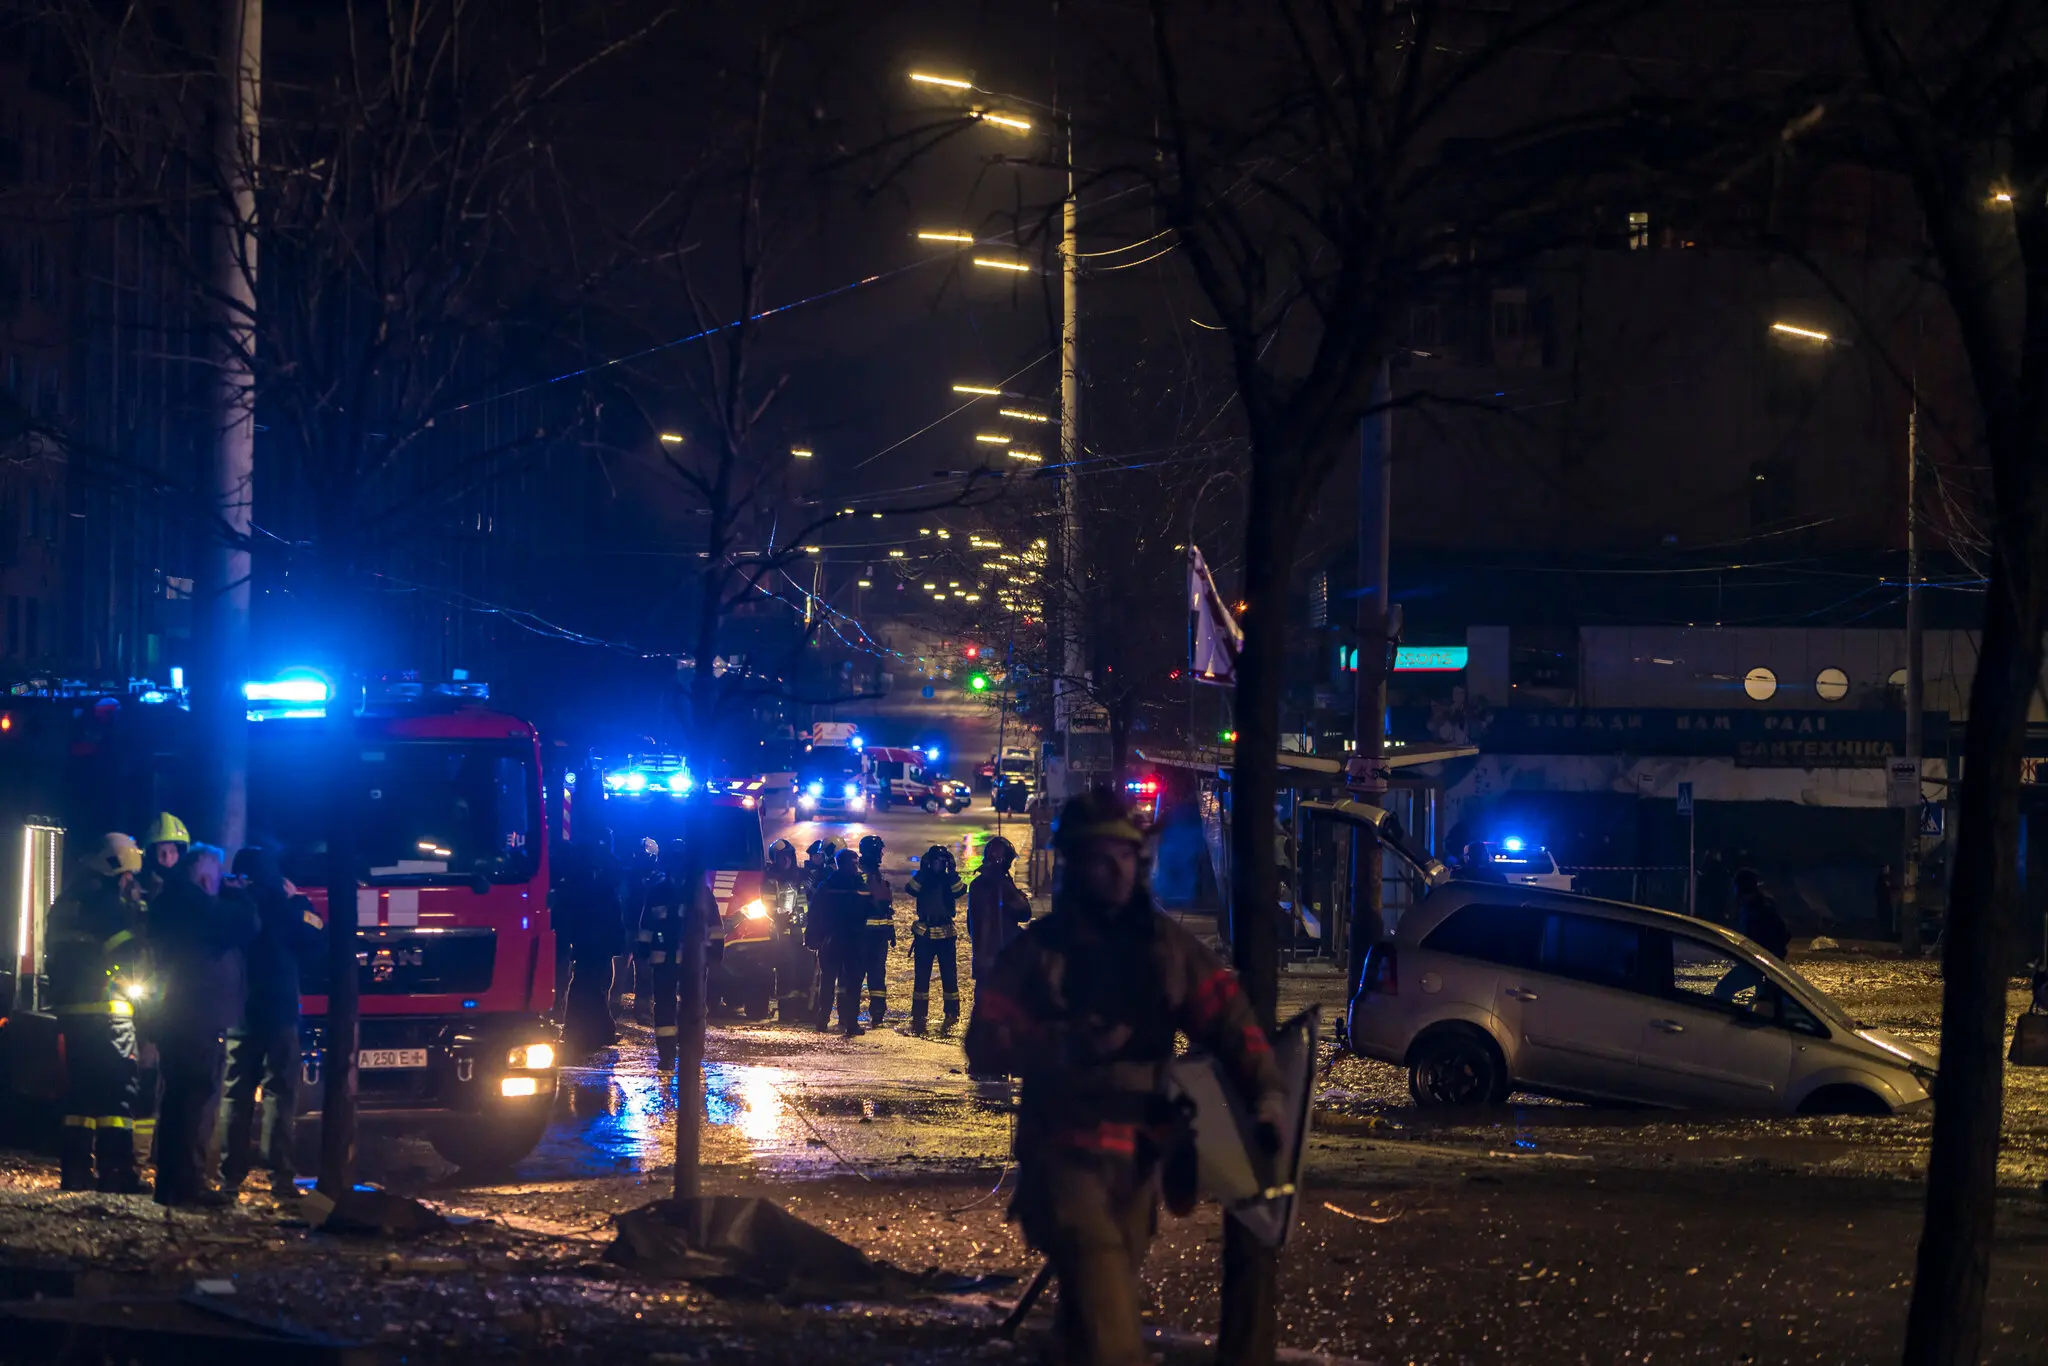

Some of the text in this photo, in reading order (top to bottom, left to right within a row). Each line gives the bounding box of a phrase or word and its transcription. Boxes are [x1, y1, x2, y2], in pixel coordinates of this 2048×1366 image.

[1396, 652, 1452, 665] tsons
[1764, 716, 1826, 733] РАДІ
[1738, 740, 1895, 757] САНТЕХНІКА
